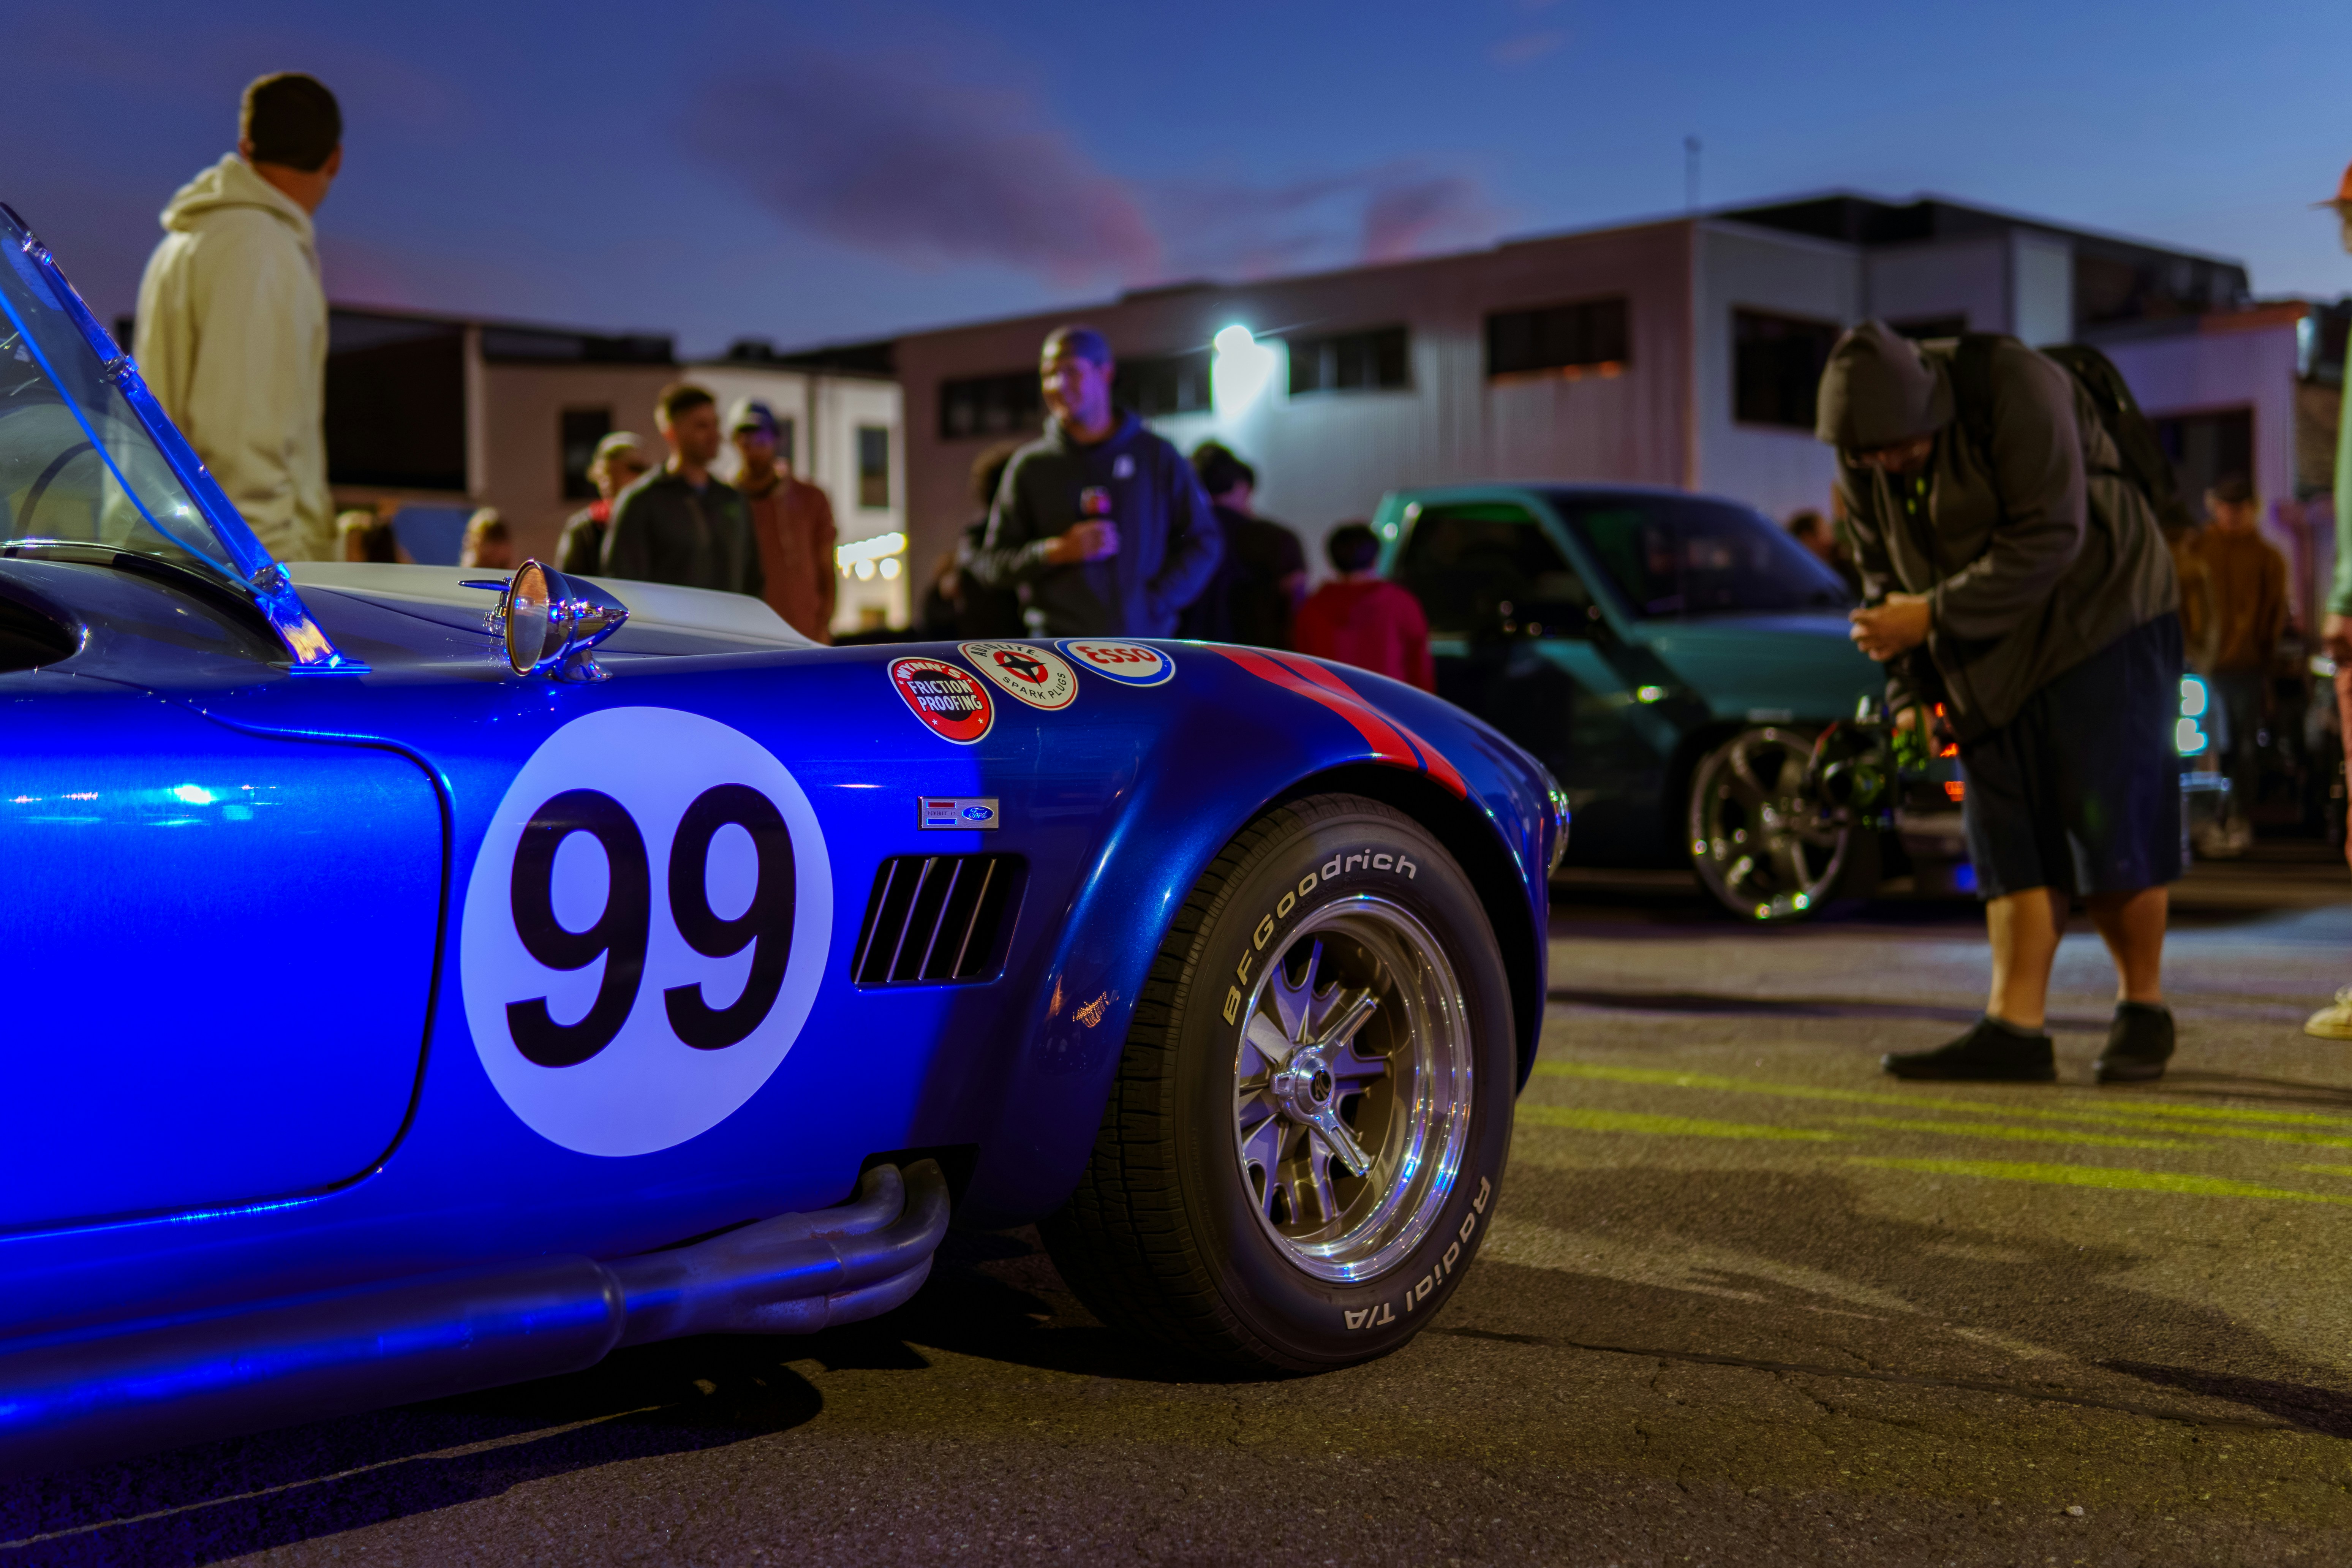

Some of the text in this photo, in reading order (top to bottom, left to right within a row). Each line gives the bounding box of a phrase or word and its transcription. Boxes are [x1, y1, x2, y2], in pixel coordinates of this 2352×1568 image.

[970, 644, 1036, 658] AUTOLITE
[897, 662, 961, 679] WYNN'S
[906, 680, 974, 694] FRICTION
[1002, 672, 1067, 700] SPARK PLUGS
[917, 694, 983, 711] PROOFING
[968, 807, 988, 819] Ford
[505, 782, 797, 1069] 99
[1223, 849, 1417, 1026] BFGoodrich
[1344, 1176, 1491, 1329] Radial T/A
